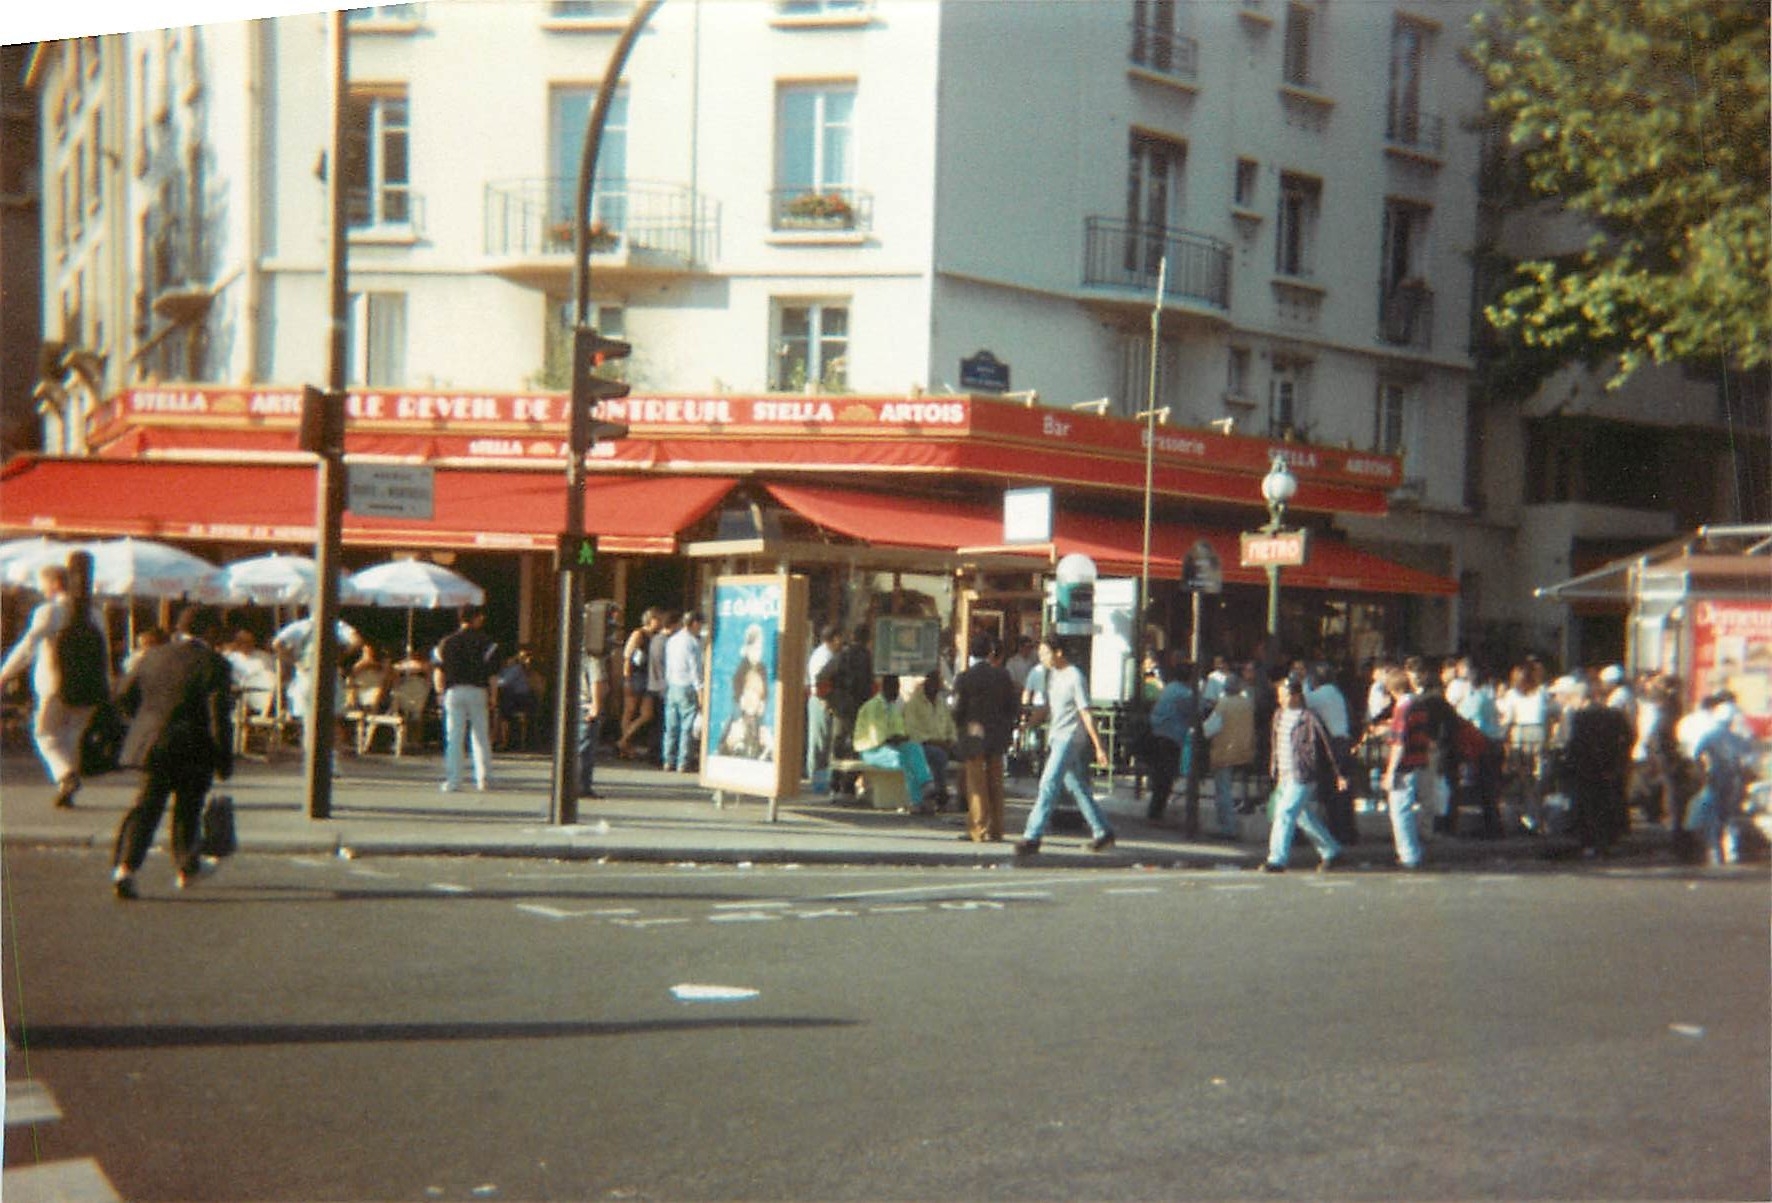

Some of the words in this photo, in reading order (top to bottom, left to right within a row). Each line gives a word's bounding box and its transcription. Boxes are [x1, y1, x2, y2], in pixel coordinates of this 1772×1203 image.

[133, 391, 208, 412] STELLA
[250, 393, 302, 414] ARTO
[346, 394, 383, 417] LE
[397, 395, 501, 419] REVEIL
[513, 397, 552, 420] DE
[562, 399, 733, 423] ONTREUIL
[753, 401, 835, 422] STELLA
[879, 403, 964, 423] ARTOIS
[1043, 412, 1071, 436] Bar
[469, 439, 524, 456] STELLA
